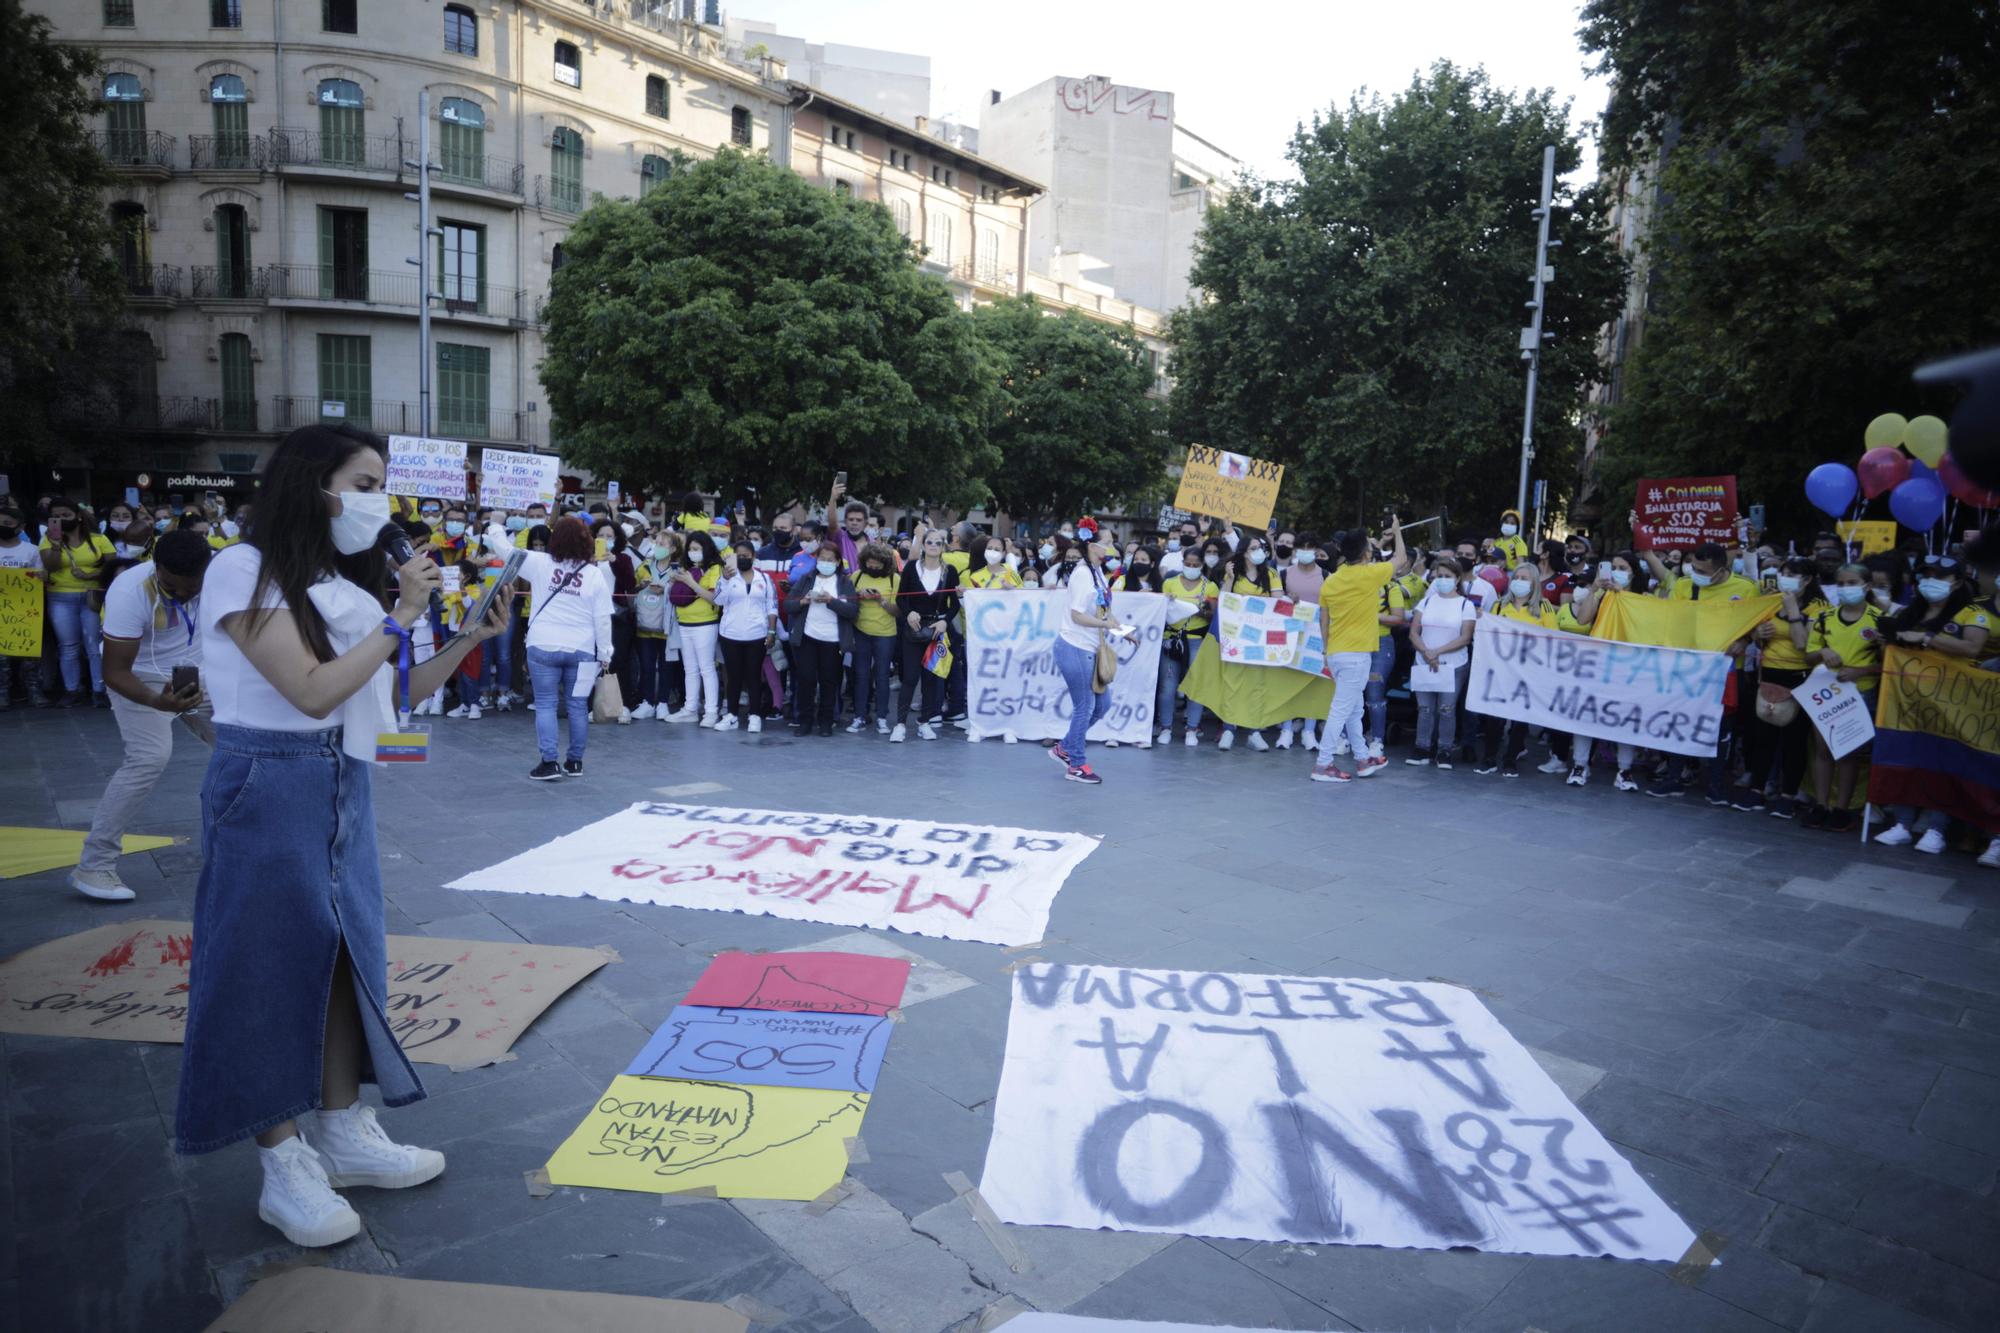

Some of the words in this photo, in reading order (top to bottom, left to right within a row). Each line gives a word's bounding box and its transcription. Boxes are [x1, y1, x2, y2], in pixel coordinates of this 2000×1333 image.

[167, 474, 235, 488] padthaiwok
[1664, 485, 1725, 499] COLOMBIA
[548, 585, 581, 597] COOMBIA
[1492, 627, 1599, 679] URIBE
[1600, 643, 1733, 705] PARA
[1481, 668, 1531, 710] LA
[1811, 682, 1842, 706] SOS
[1817, 696, 1857, 721] COLOMBIA
[638, 802, 900, 840] reforma
[1017, 962, 1455, 1029] REFORMA
[679, 1040, 846, 1076] SOS
[1073, 1016, 1314, 1100] LA
[1382, 1029, 1513, 1113] A
[598, 1097, 738, 1128] MATANDO
[600, 1121, 719, 1146] ESTAN
[588, 1139, 678, 1163] NOS
[1073, 1097, 1487, 1244] NO
